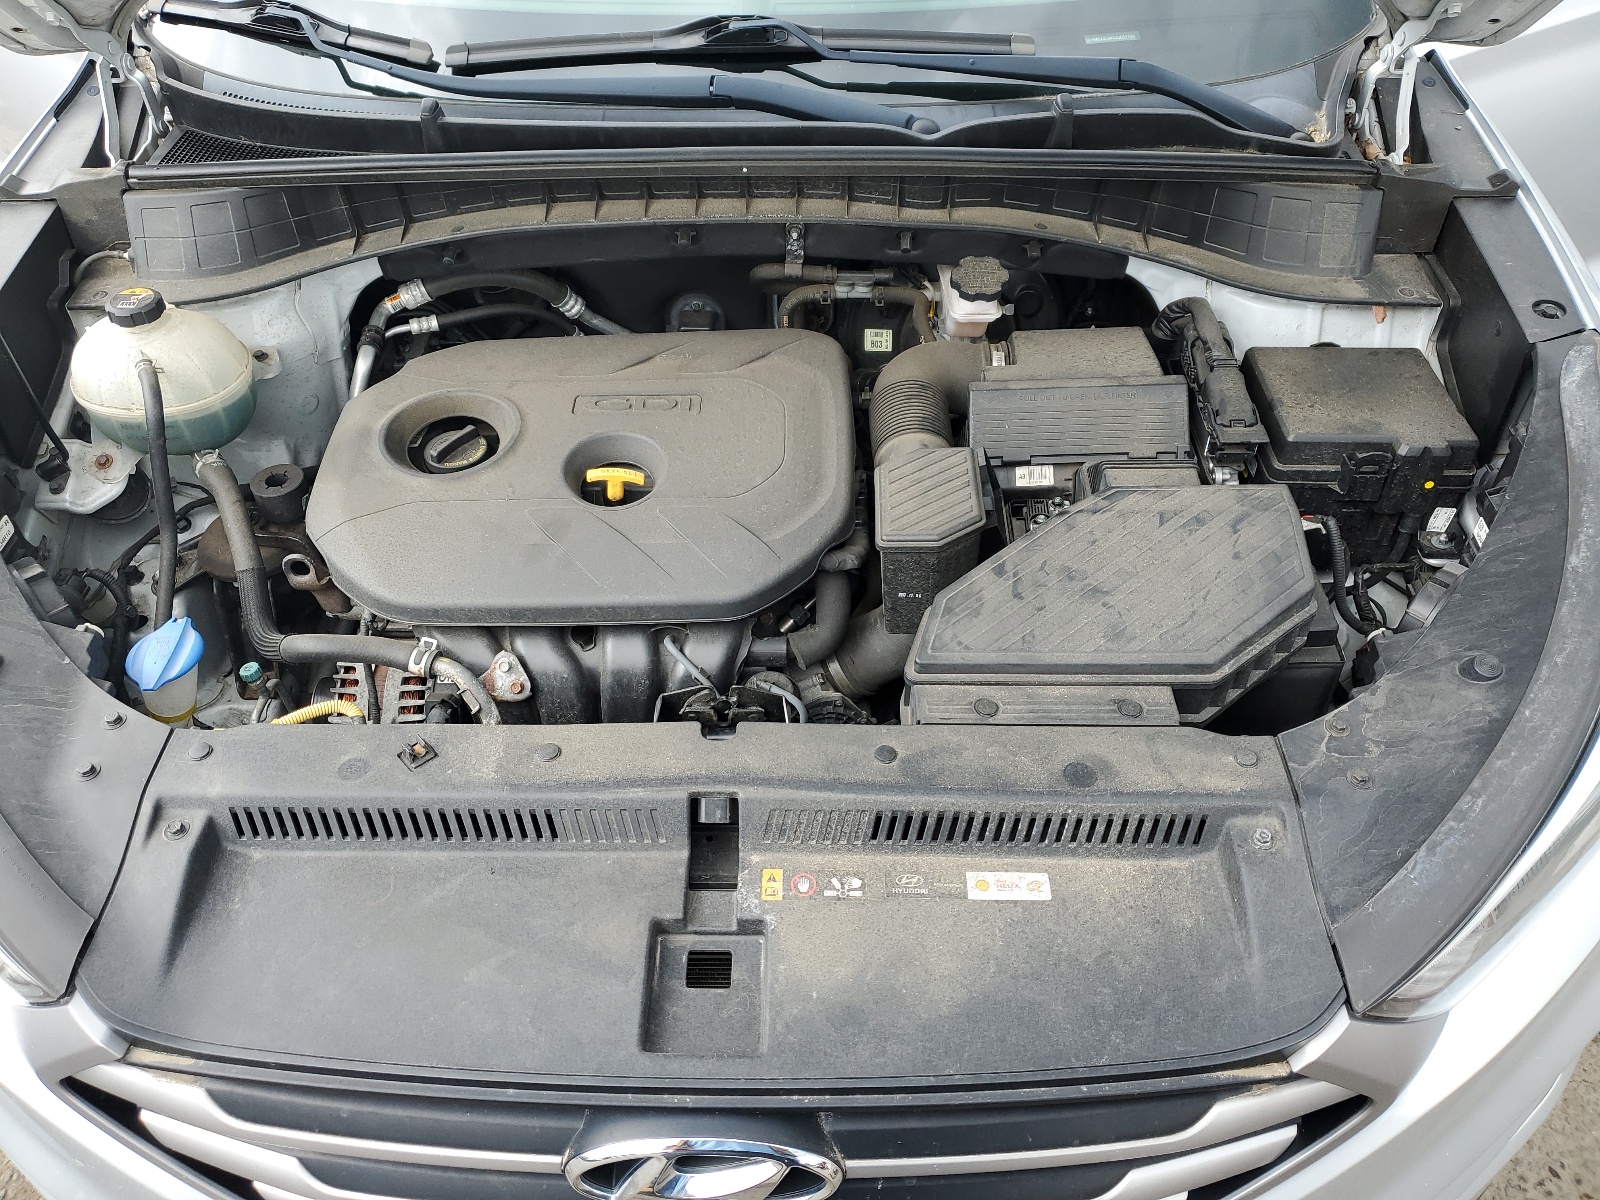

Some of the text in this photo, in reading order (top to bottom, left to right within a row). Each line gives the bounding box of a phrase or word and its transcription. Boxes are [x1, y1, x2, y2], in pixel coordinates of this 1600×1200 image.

[870, 340, 883, 349] B03
[1069, 393, 1090, 401] OPEN
[584, 397, 692, 412] GDI
[892, 887, 929, 895] HYUNDAI
